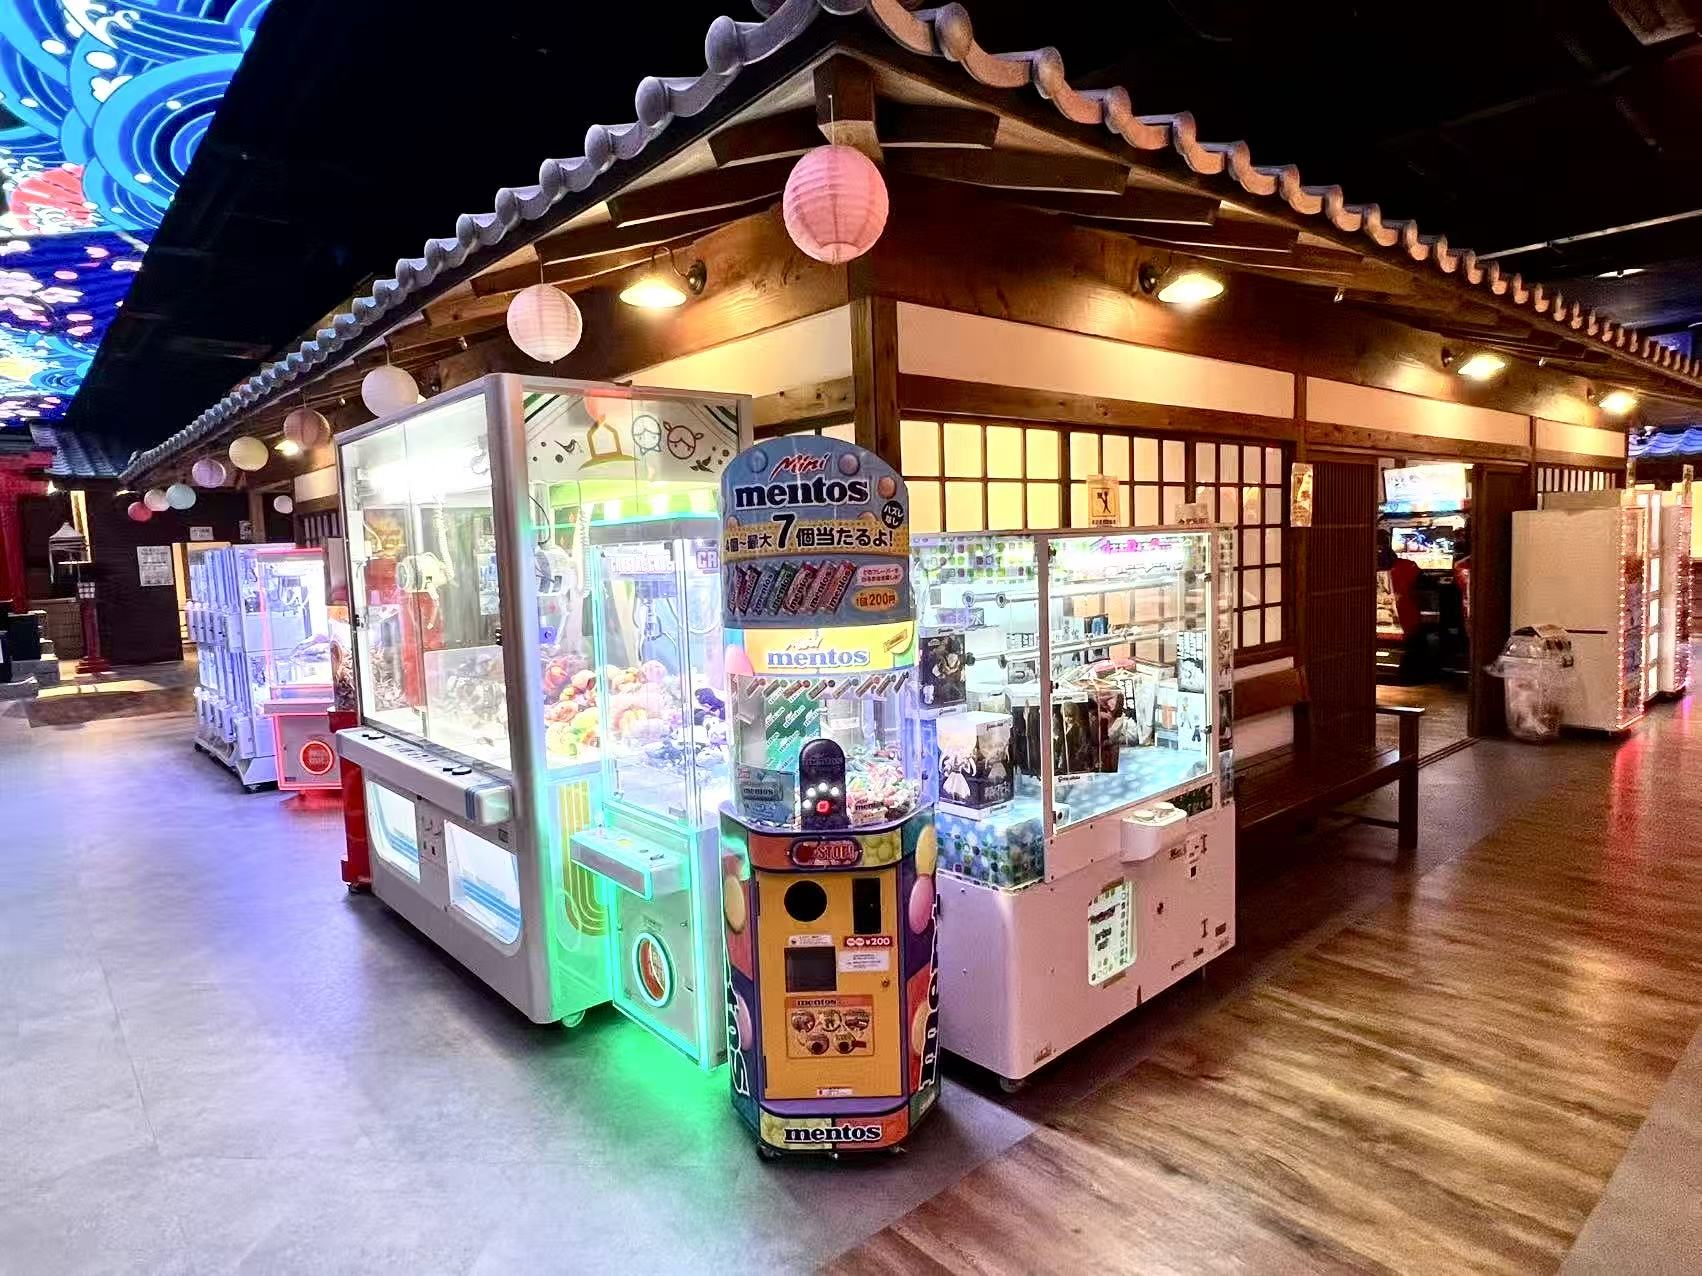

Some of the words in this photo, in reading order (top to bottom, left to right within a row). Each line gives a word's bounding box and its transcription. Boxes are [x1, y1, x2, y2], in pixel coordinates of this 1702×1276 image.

[735, 476, 870, 508] mentos
[767, 648, 870, 668] mentos
[797, 999, 837, 1007] mentos
[784, 1124, 882, 1144] mentos
